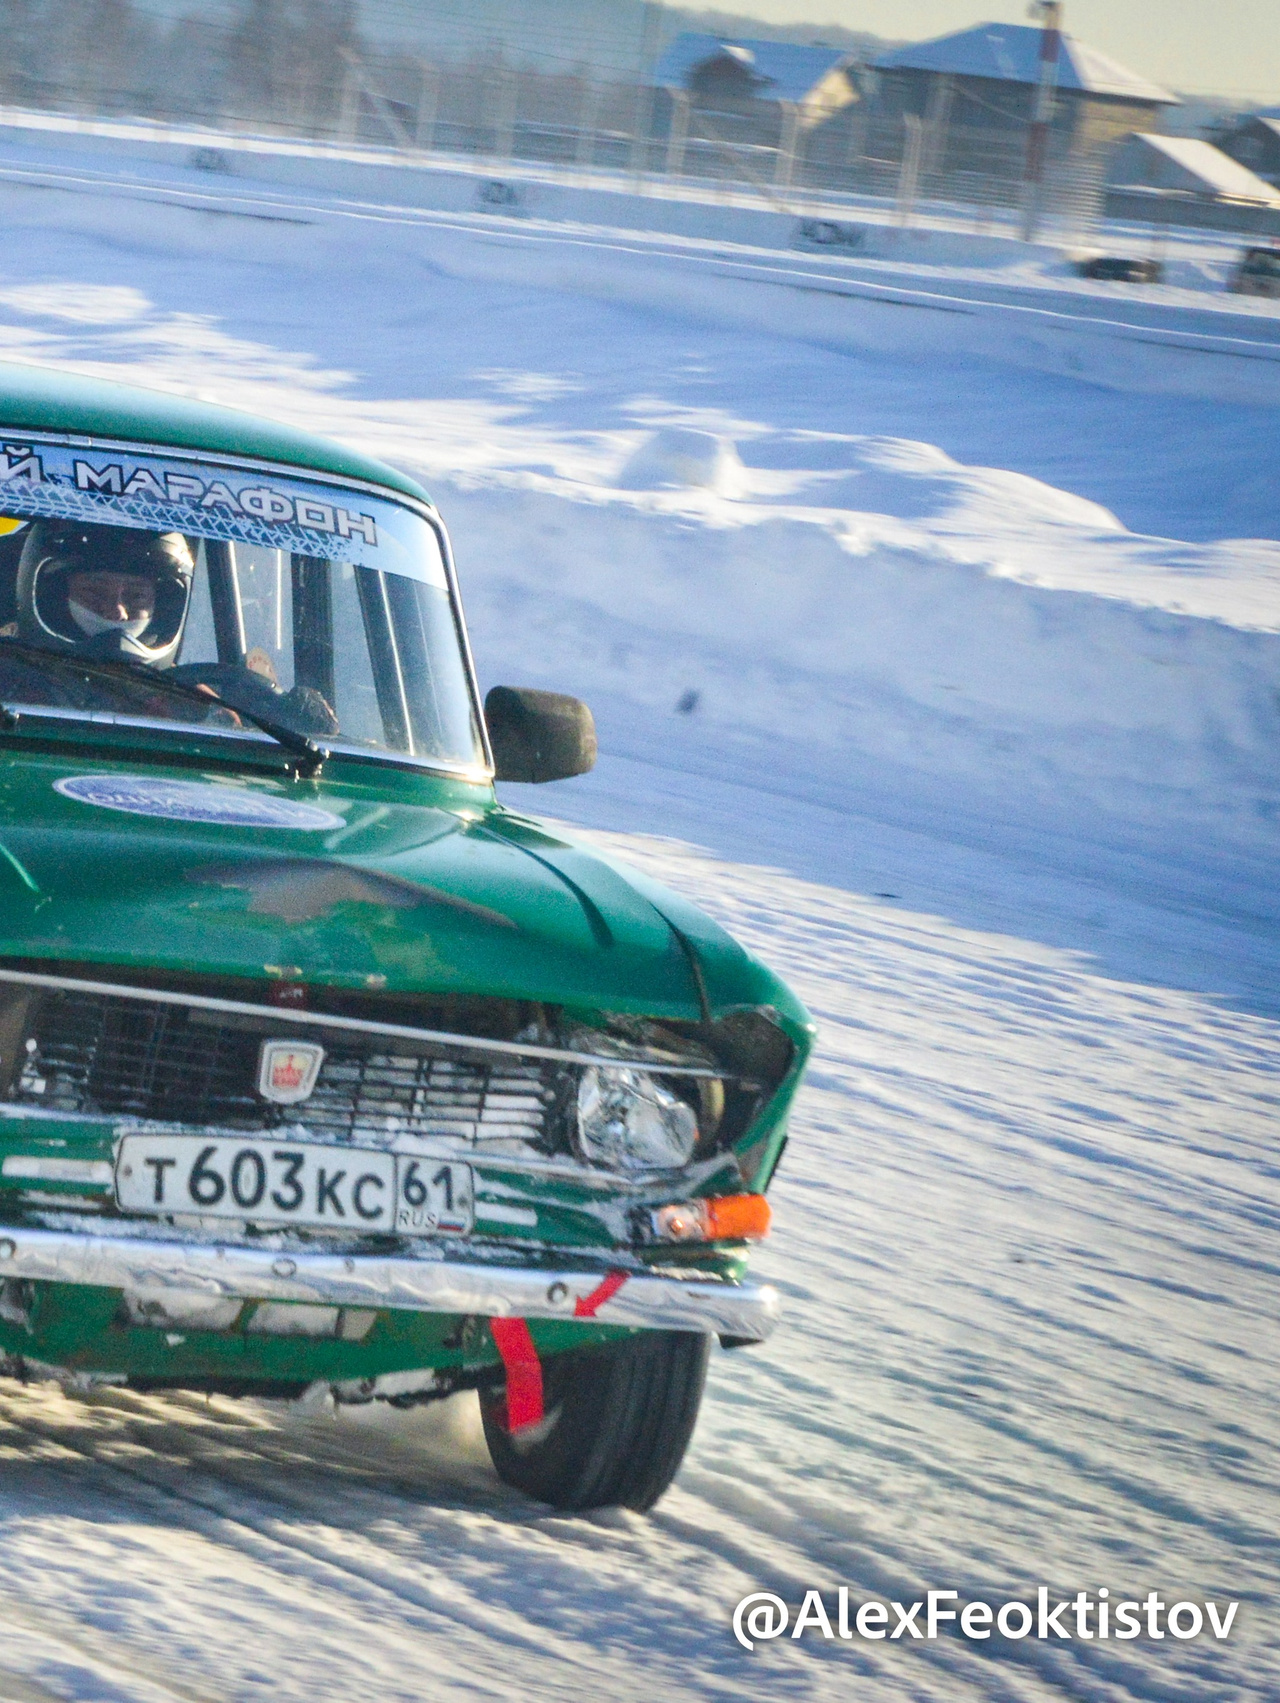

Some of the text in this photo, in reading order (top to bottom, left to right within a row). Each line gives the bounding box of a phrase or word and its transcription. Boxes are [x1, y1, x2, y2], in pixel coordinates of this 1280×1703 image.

[73, 459, 378, 547] МАРАФОН
[403, 1161, 454, 1211] 61
[399, 1211, 437, 1228] RUS
